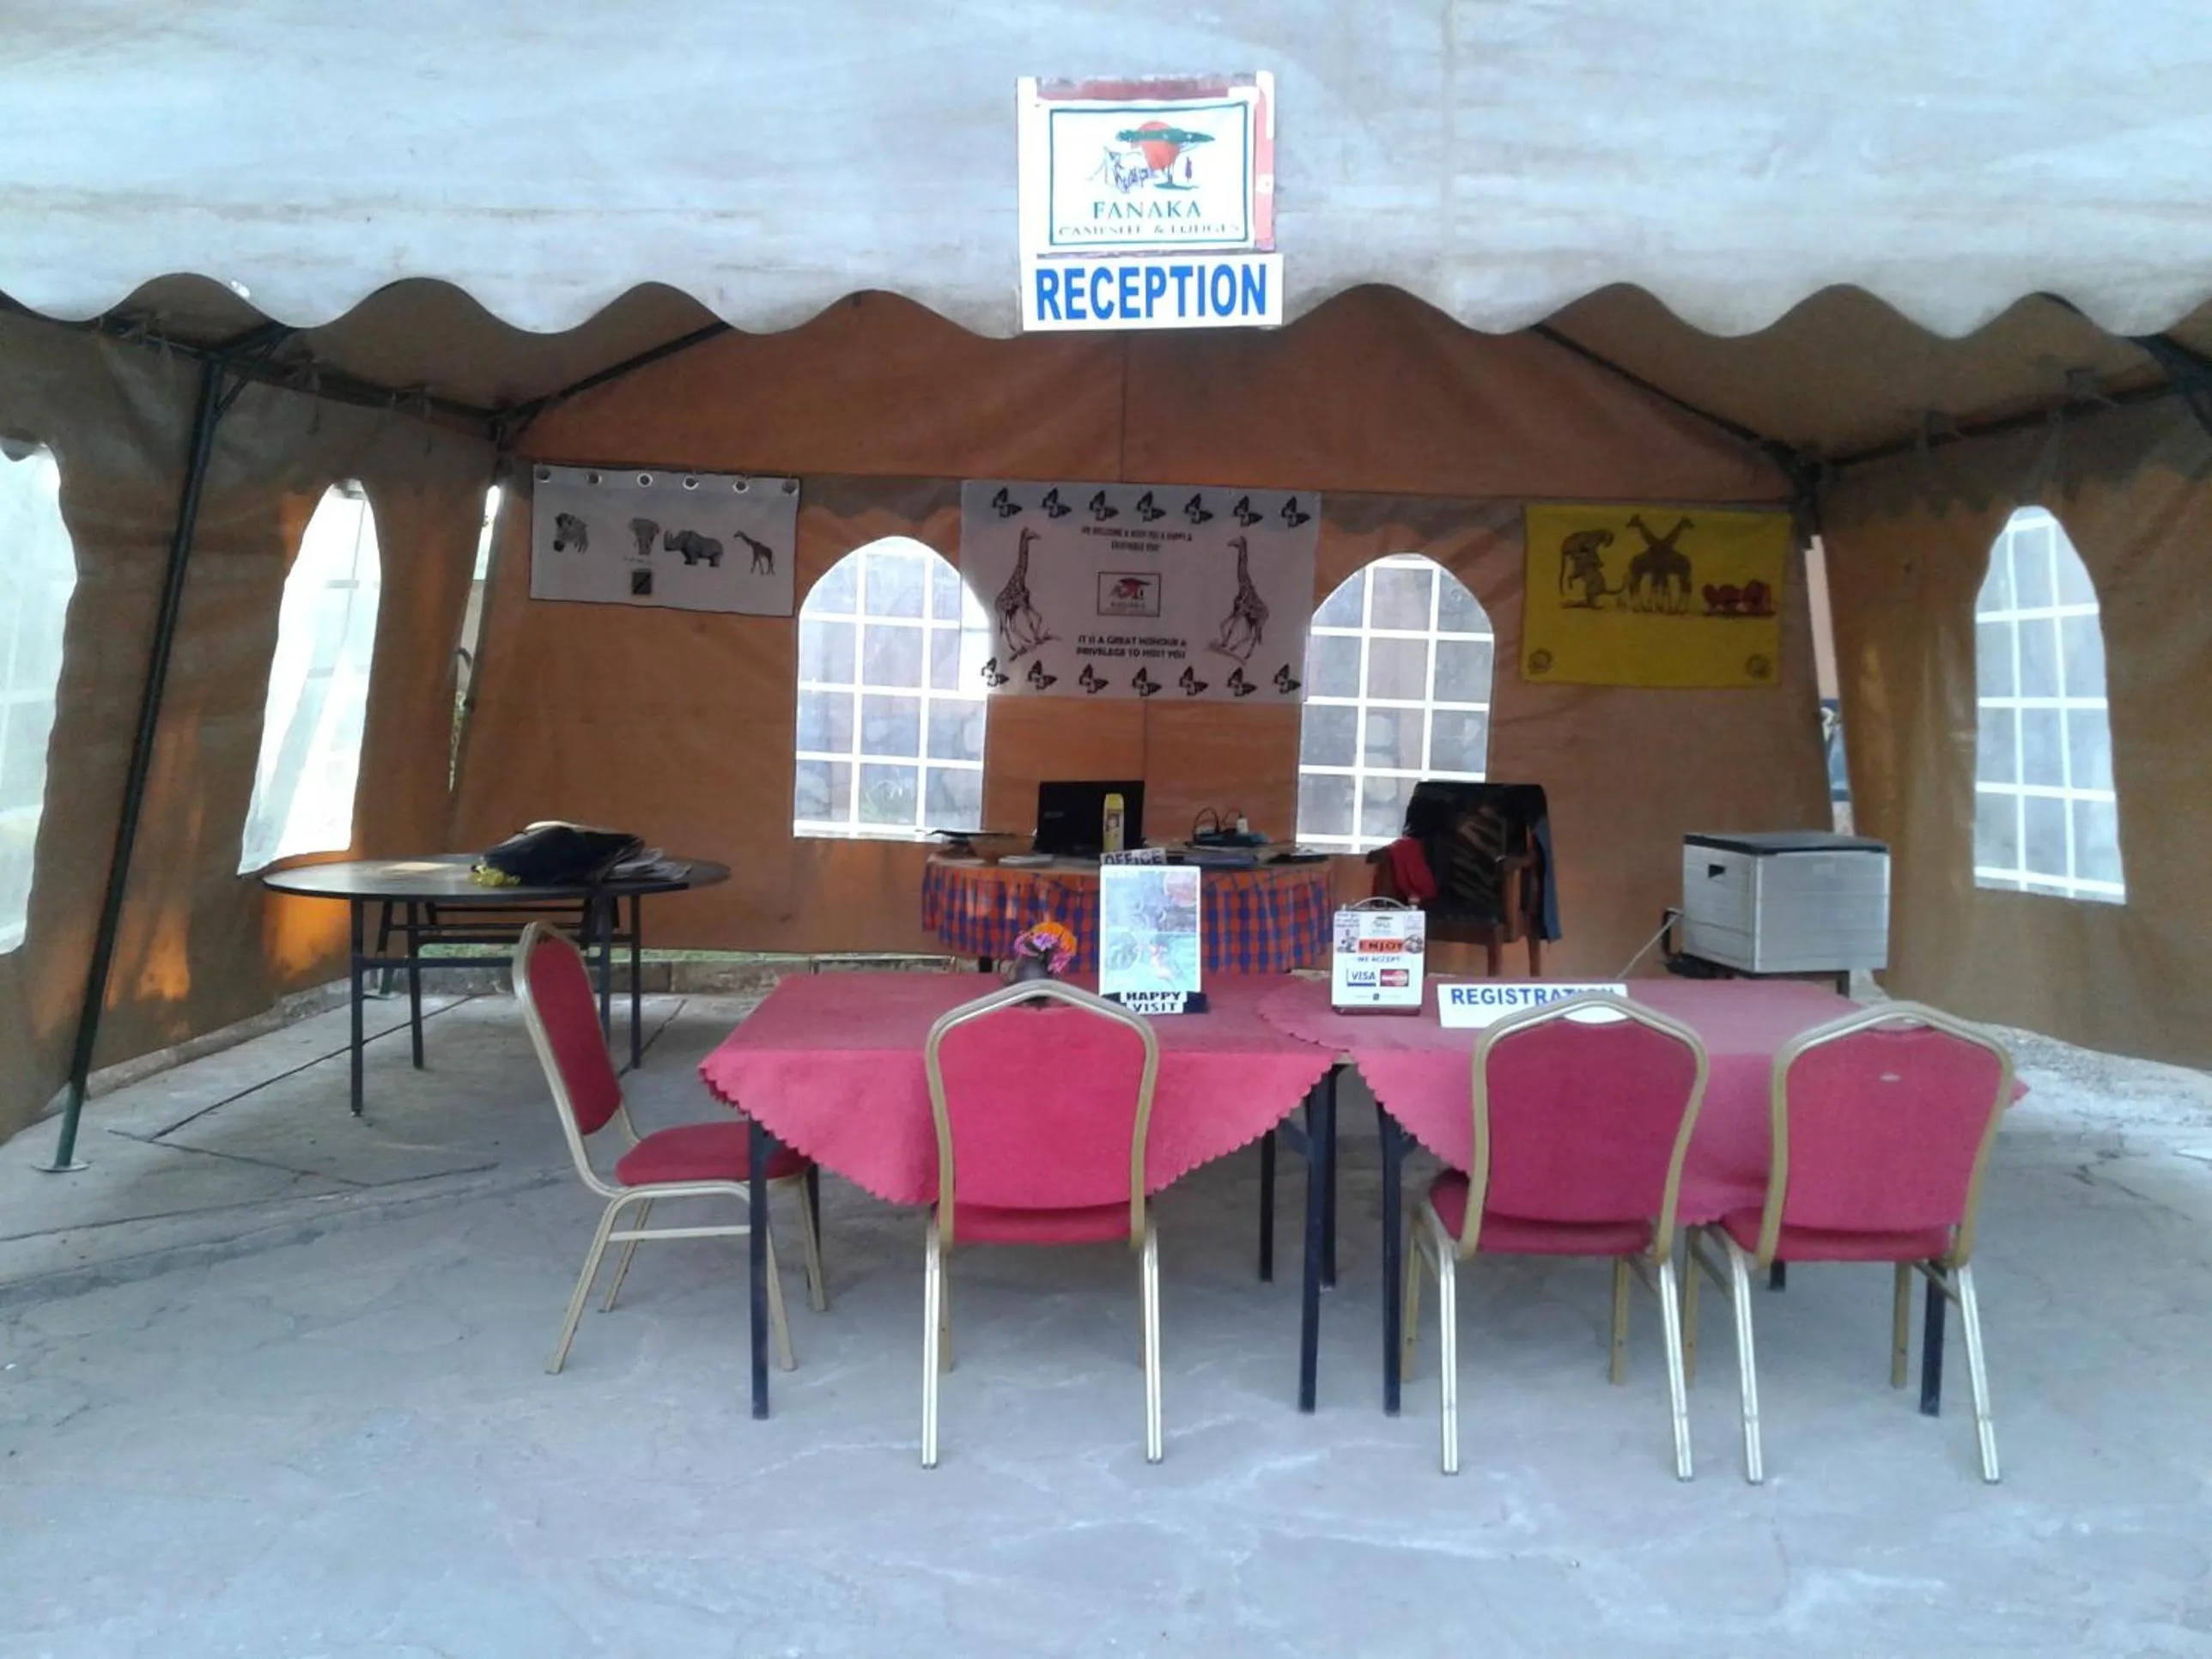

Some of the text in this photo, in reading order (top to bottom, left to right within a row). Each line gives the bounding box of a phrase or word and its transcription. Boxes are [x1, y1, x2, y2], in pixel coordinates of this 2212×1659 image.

[1093, 200, 1201, 220] FANAKA
[1036, 264, 1267, 321] RECEPTION
[1106, 635, 1137, 646] GREAT
[1128, 648, 1140, 658] TO
[1103, 850, 1161, 866] OFFICE
[1352, 970, 1376, 981] VISA
[1126, 991, 1181, 1001] HAPPY
[1451, 987, 1616, 1006] REGISTRAT
[1133, 1002, 1177, 1012] VISIT
